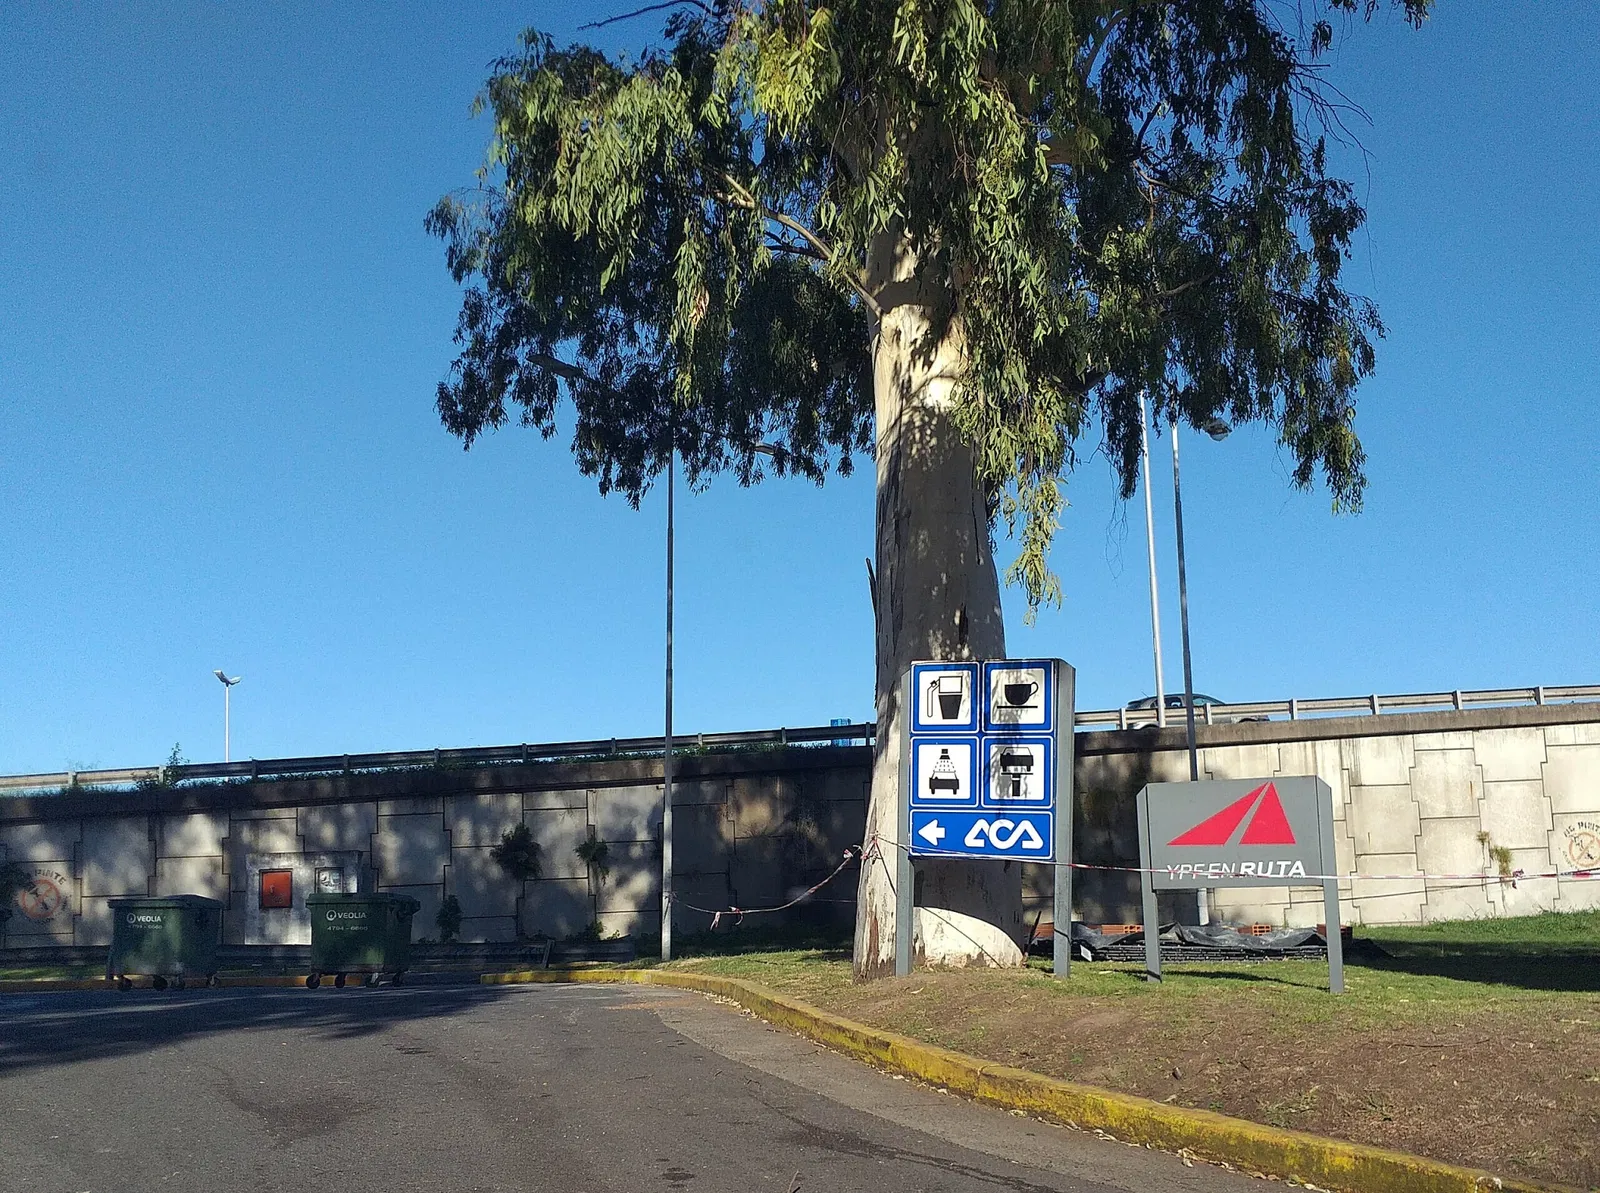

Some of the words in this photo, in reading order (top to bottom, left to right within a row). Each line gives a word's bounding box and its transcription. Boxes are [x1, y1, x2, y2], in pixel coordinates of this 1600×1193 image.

[964, 818, 1044, 850] ACA
[35, 868, 67, 885] PINTE
[1167, 863, 1205, 880] YPF
[1207, 862, 1236, 879] EN
[1239, 860, 1306, 879] RUTA
